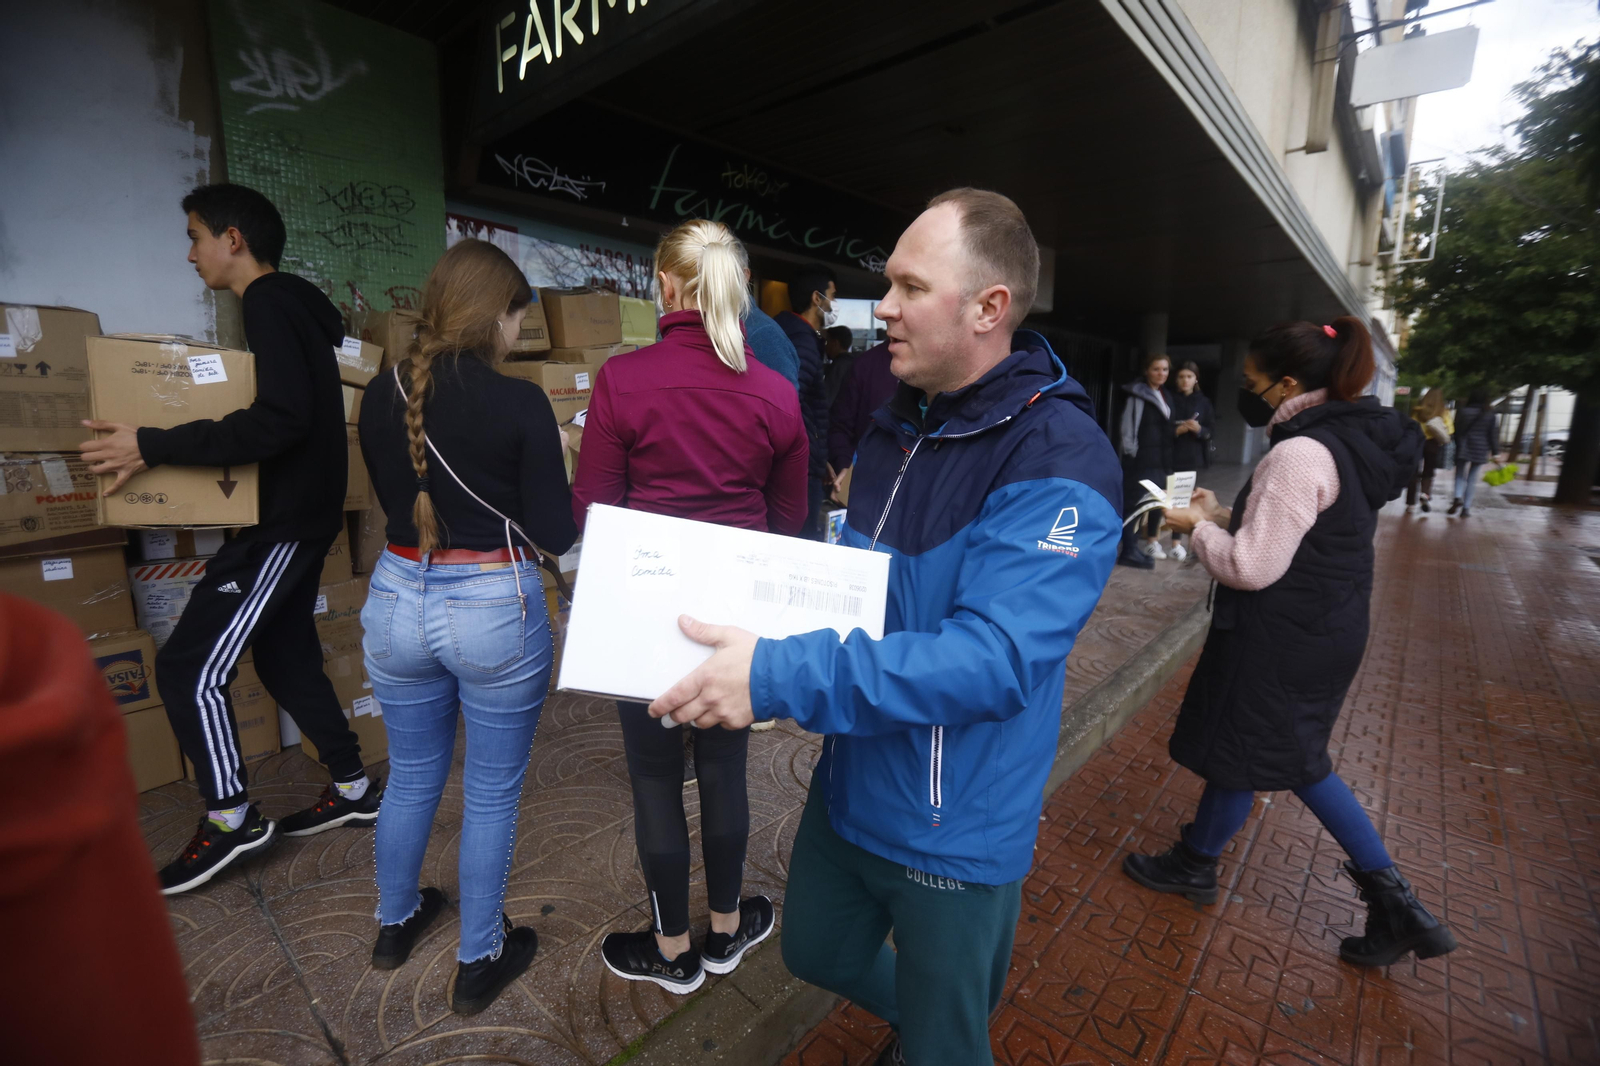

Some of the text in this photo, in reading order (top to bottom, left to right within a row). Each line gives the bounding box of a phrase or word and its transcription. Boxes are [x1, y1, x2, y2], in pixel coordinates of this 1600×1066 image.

[495, 0, 649, 94] FAR
[107, 664, 146, 684] FAISA
[906, 866, 966, 891] COLLEGE
[724, 932, 748, 956] FILA
[652, 962, 685, 978] FILA
